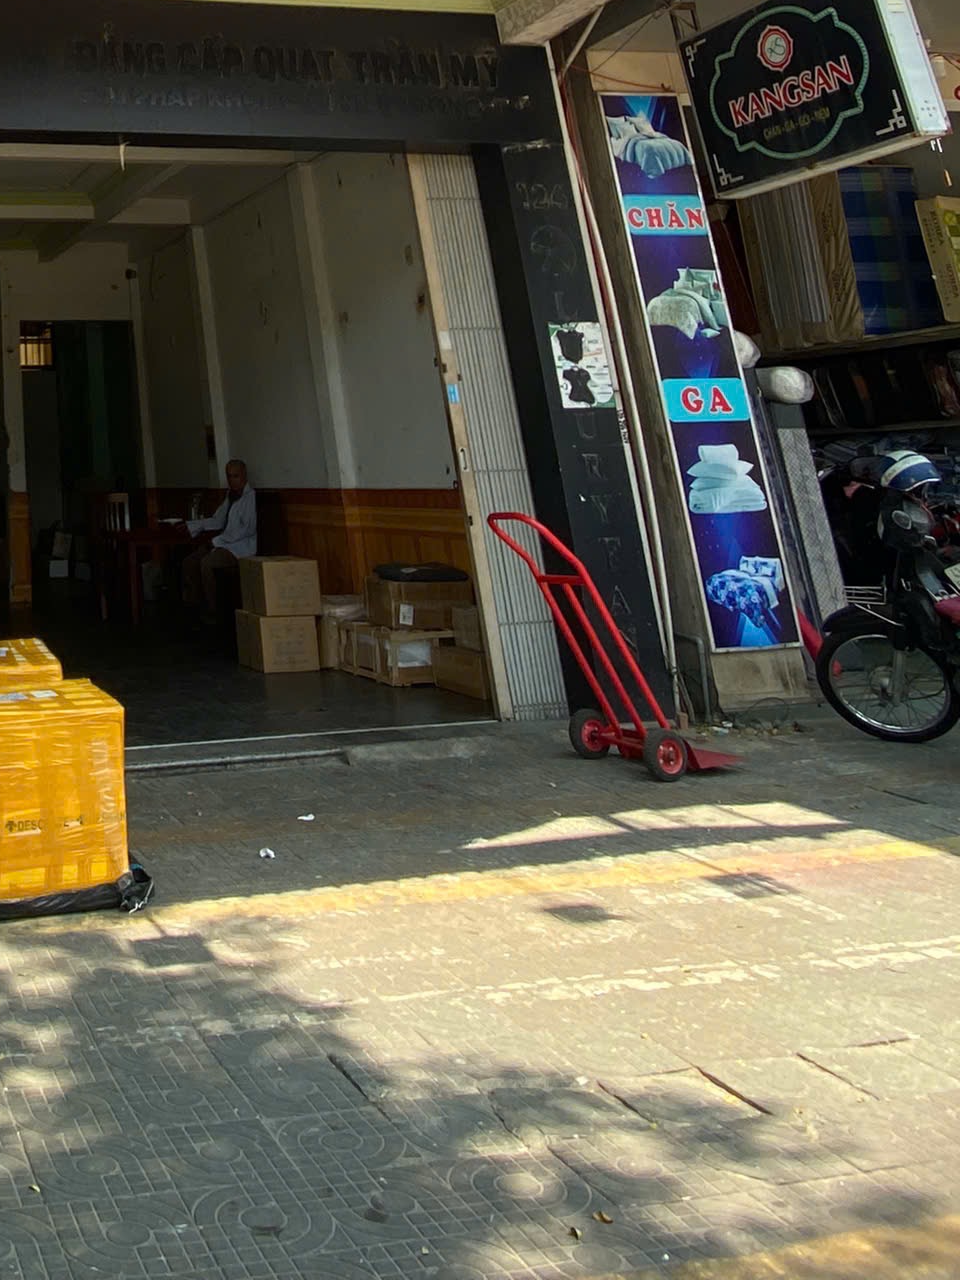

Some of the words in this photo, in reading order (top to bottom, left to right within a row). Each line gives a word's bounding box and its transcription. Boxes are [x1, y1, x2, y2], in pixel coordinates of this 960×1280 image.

[728, 55, 855, 129] KANGSAN
[628, 200, 704, 229] CHĂN
[681, 385, 734, 415] GA
